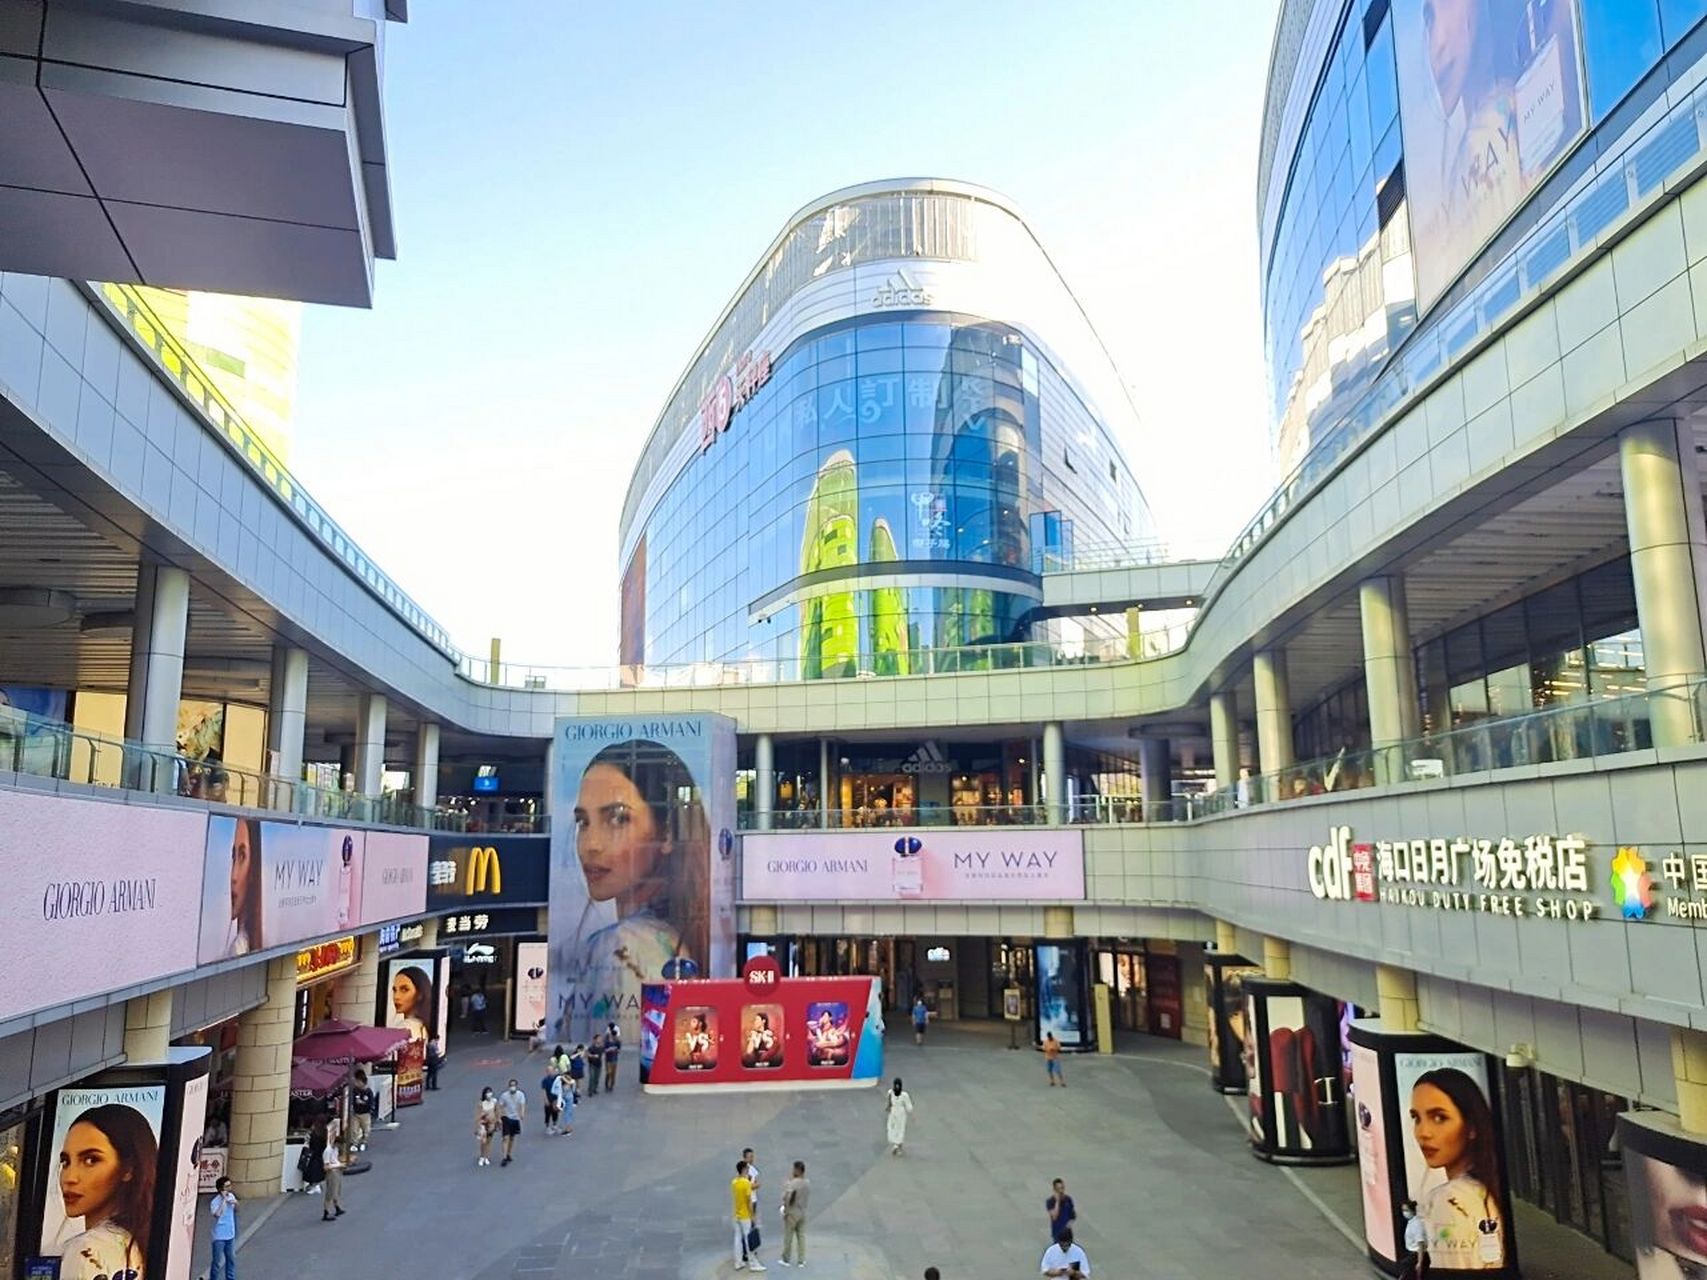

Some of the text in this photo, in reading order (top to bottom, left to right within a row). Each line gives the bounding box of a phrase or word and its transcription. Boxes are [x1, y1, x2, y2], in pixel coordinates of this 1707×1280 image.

[872, 288, 934, 308] adidas
[565, 719, 702, 741] GIORGIO ARMANI
[902, 760, 952, 773] adidas
[767, 859, 868, 873] GIORGIO ARMANI
[954, 851, 1058, 869] MY WAY
[1308, 826, 1353, 900] cdf
[1376, 834, 1588, 892] 海口日月广场免税店
[274, 859, 323, 890] MY WAY
[1662, 851, 1707, 892] 中国
[43, 880, 105, 921] GIORGIO
[1379, 887, 1593, 921] HAIKOU DUTY FREE SHOP
[446, 914, 489, 933] 麦当劳
[559, 992, 640, 1010] MY WA
[685, 1031, 710, 1053] VS
[750, 1029, 774, 1049] VS
[62, 1090, 158, 1106] GIORGIO ARMANI
